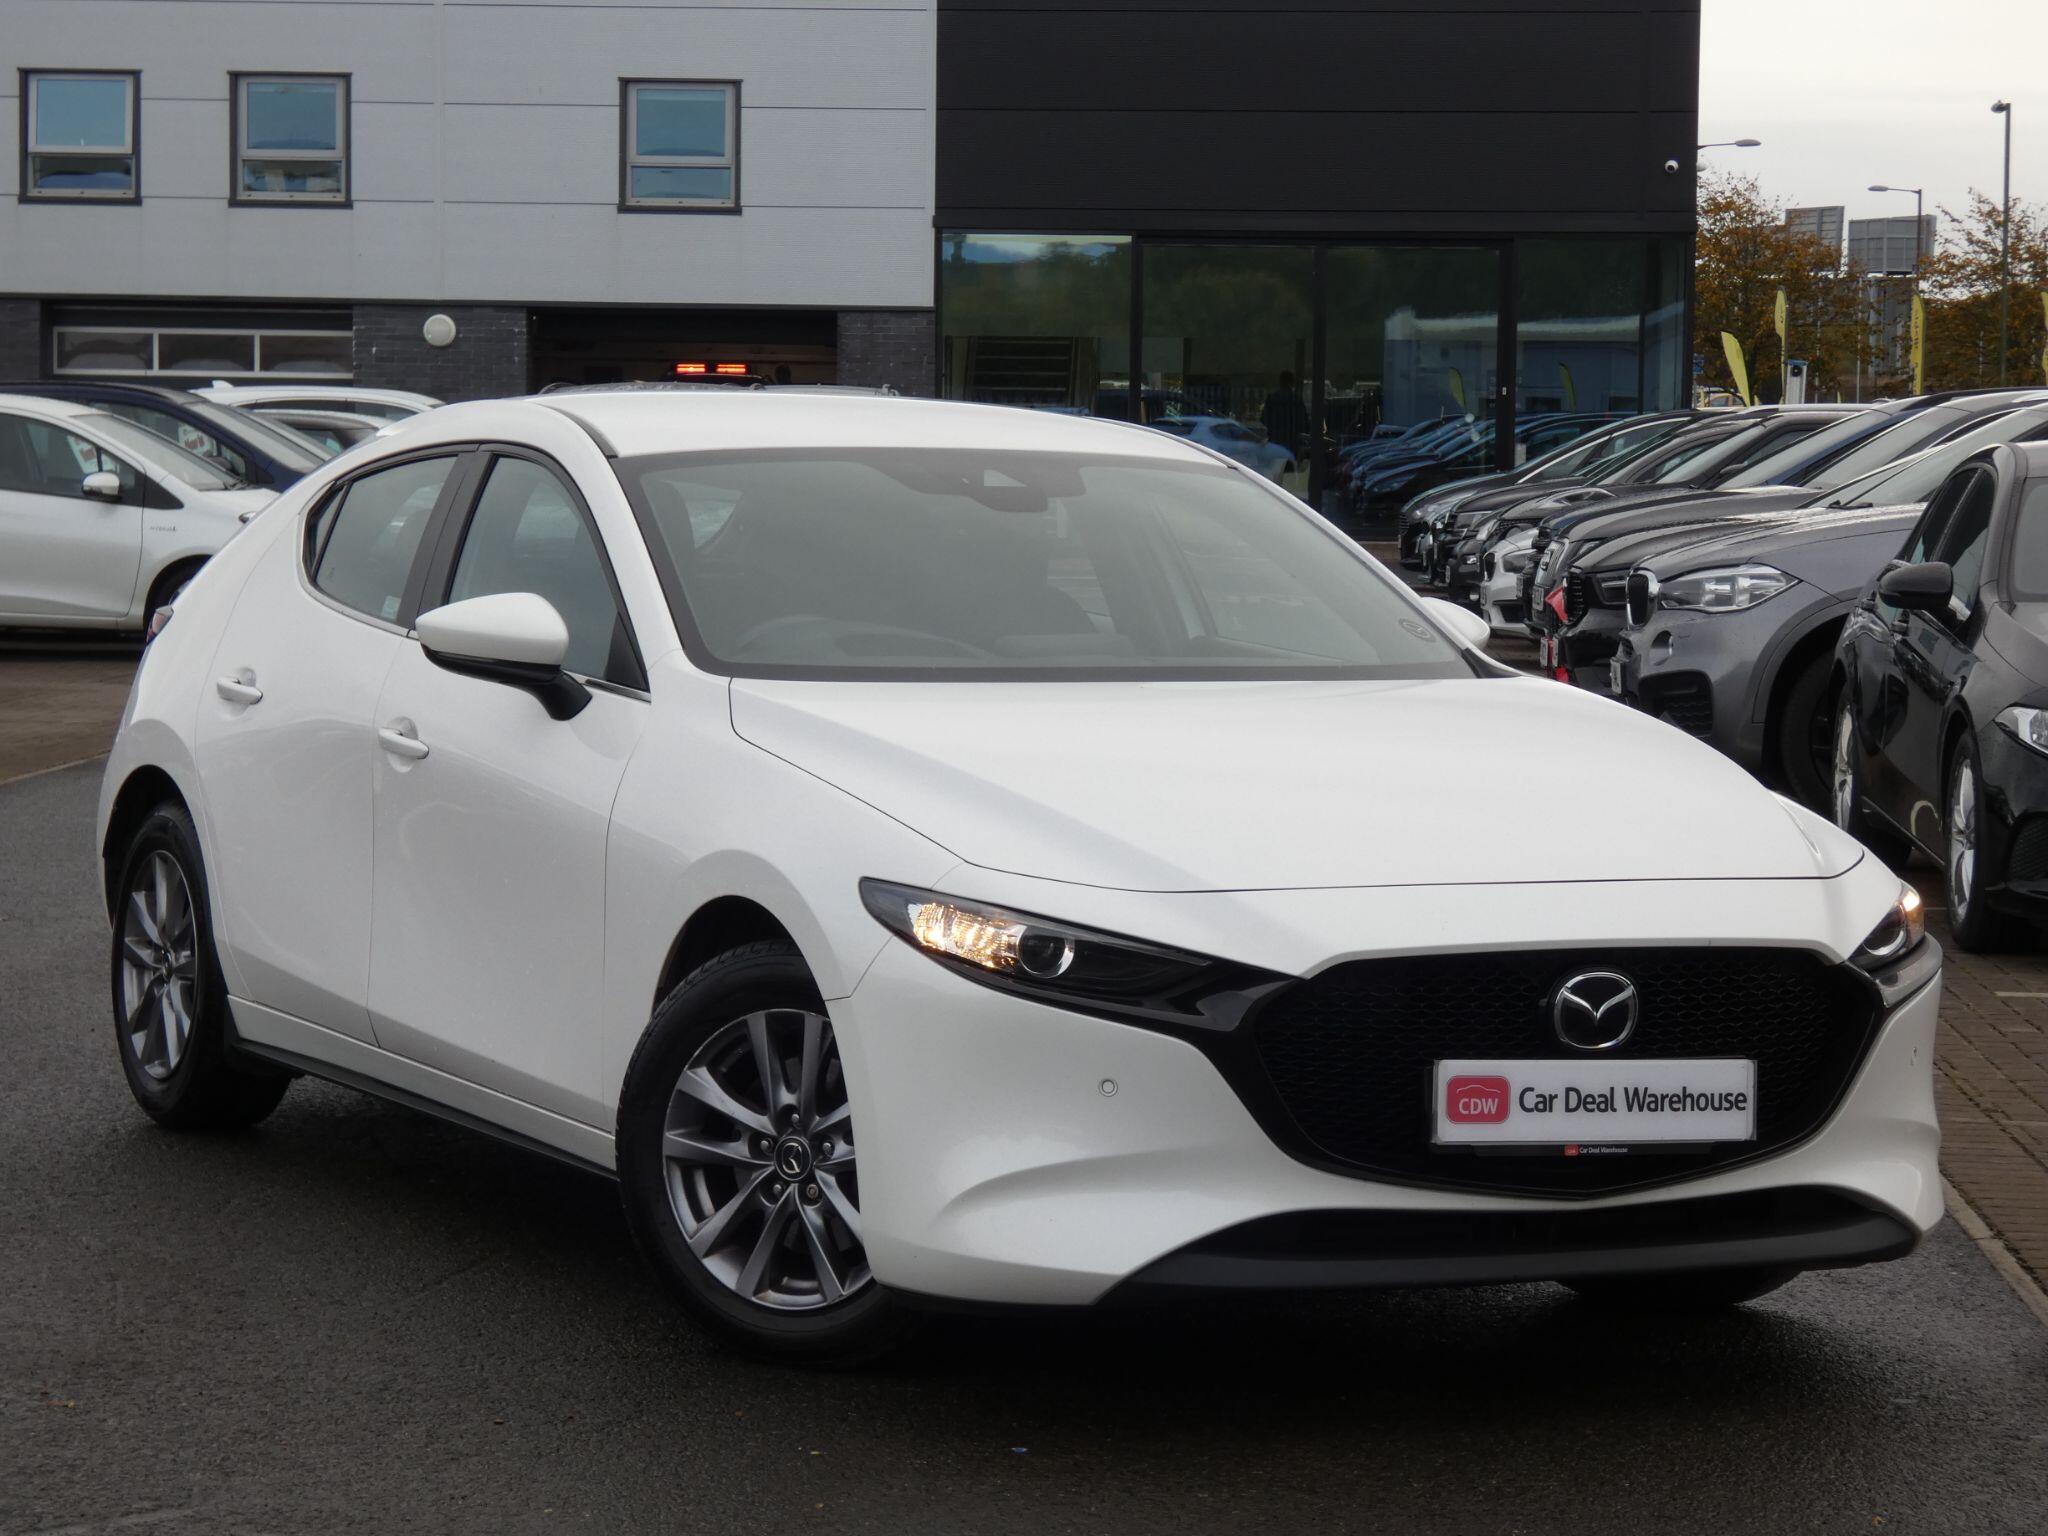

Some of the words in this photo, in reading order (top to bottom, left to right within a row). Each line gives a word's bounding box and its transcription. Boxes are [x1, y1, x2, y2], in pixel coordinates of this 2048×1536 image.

[1458, 1097, 1499, 1115] CDW
[1519, 1087, 1558, 1113] Car
[1564, 1086, 1617, 1113] Deal
[1623, 1086, 1748, 1113] Warehouse
